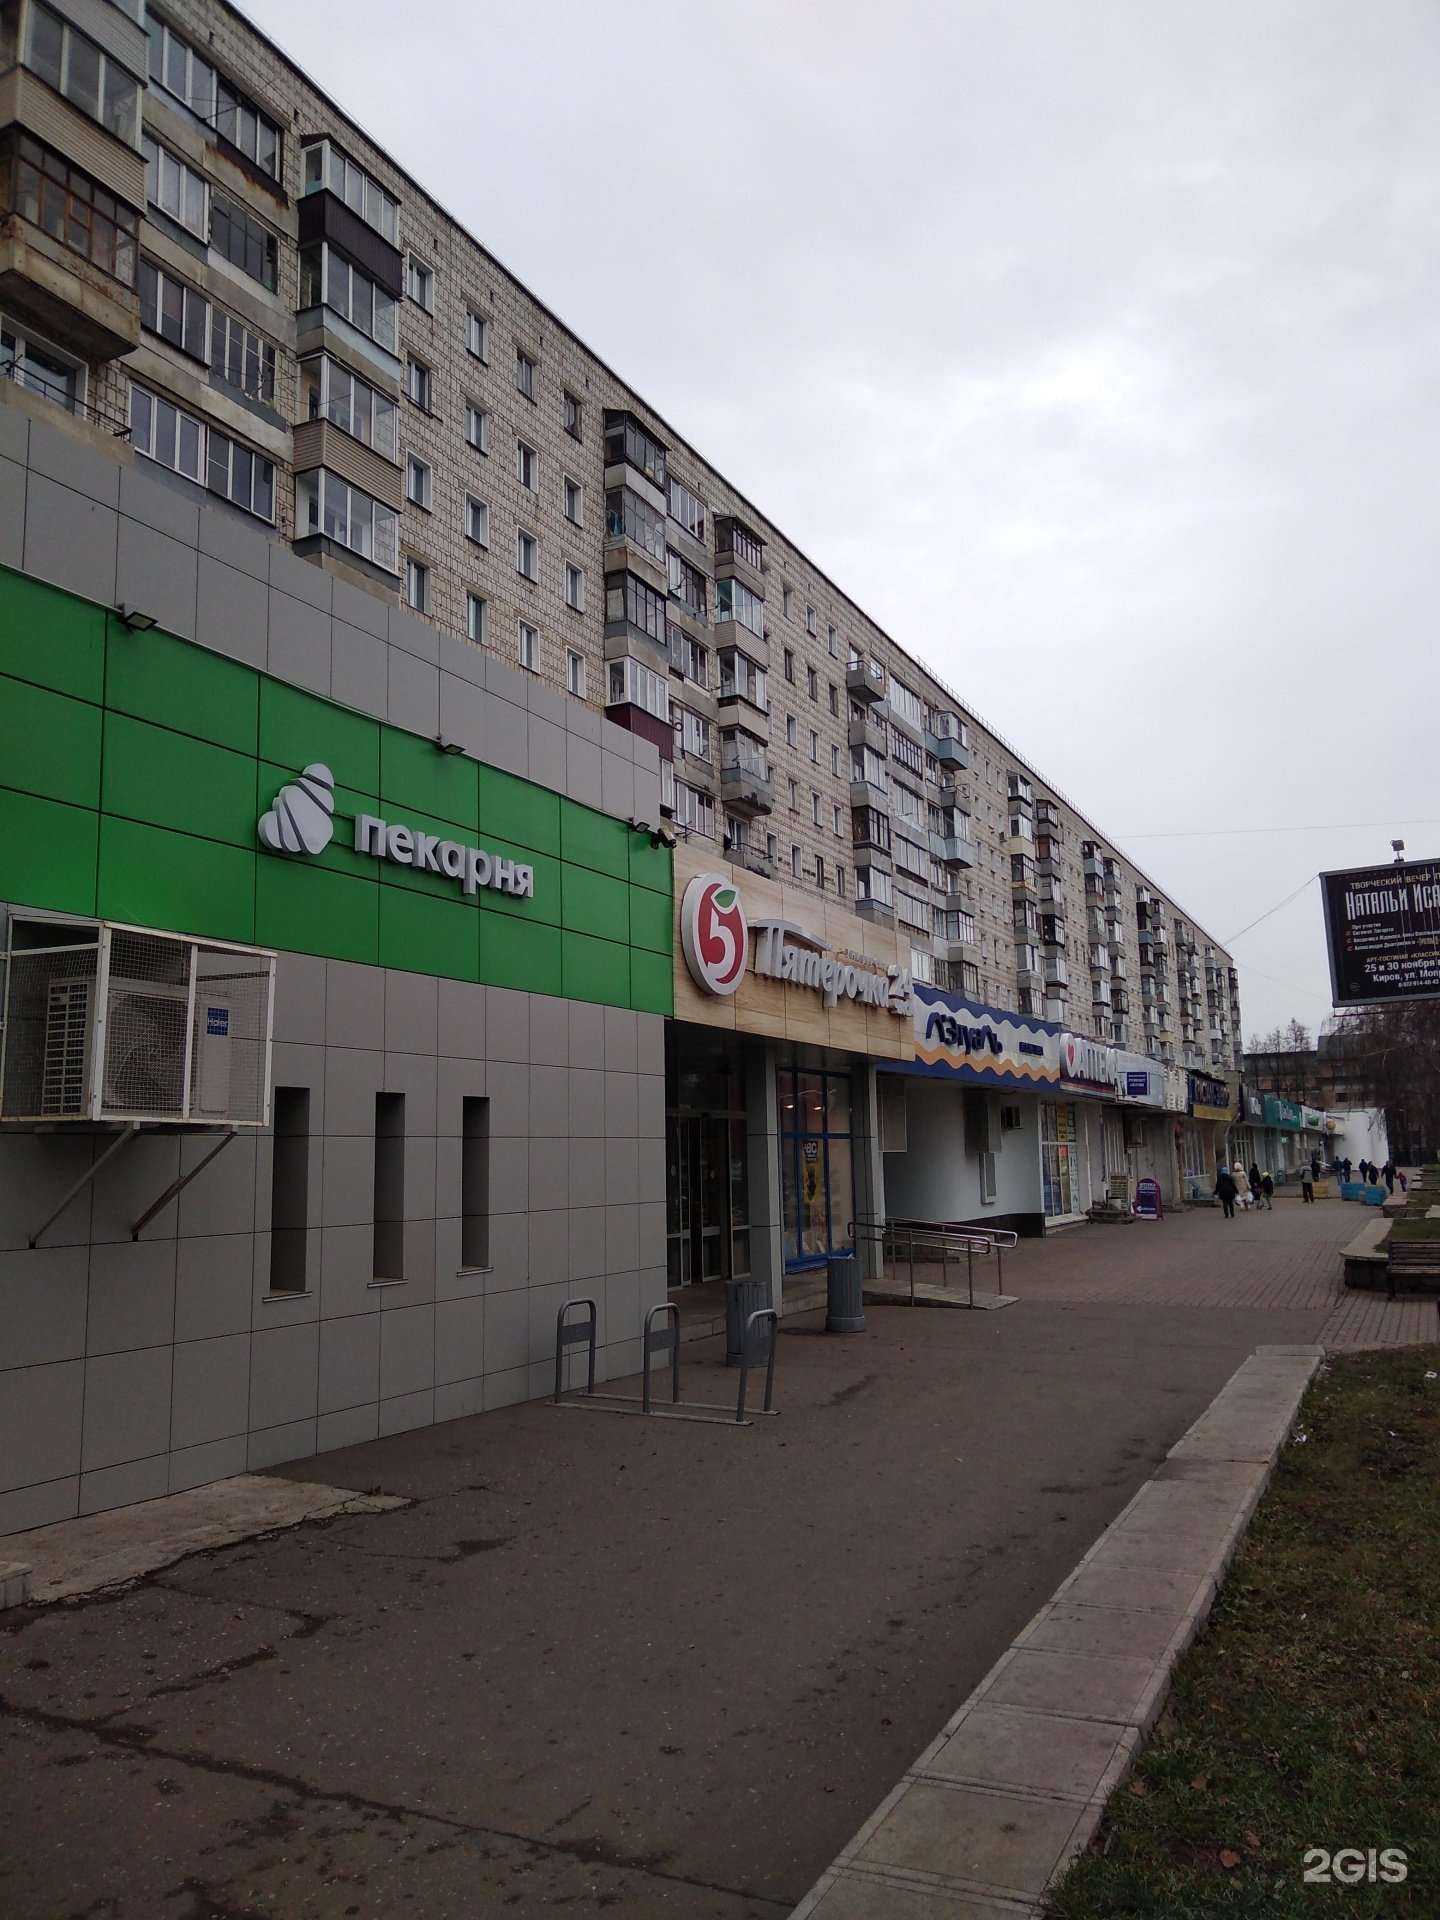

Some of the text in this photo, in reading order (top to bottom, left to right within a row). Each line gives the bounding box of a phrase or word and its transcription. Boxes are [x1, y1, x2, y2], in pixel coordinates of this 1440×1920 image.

[354, 814, 534, 898] пекарня
[1351, 876, 1402, 890] ТВОРЧЕСКИЙ
[1406, 873, 1431, 884] ВЕЧЕР
[748, 919, 889, 1008] Пятерочка
[1365, 963, 1377, 973] 25
[1387, 961, 1399, 971] 30
[1401, 958, 1435, 969] ноября
